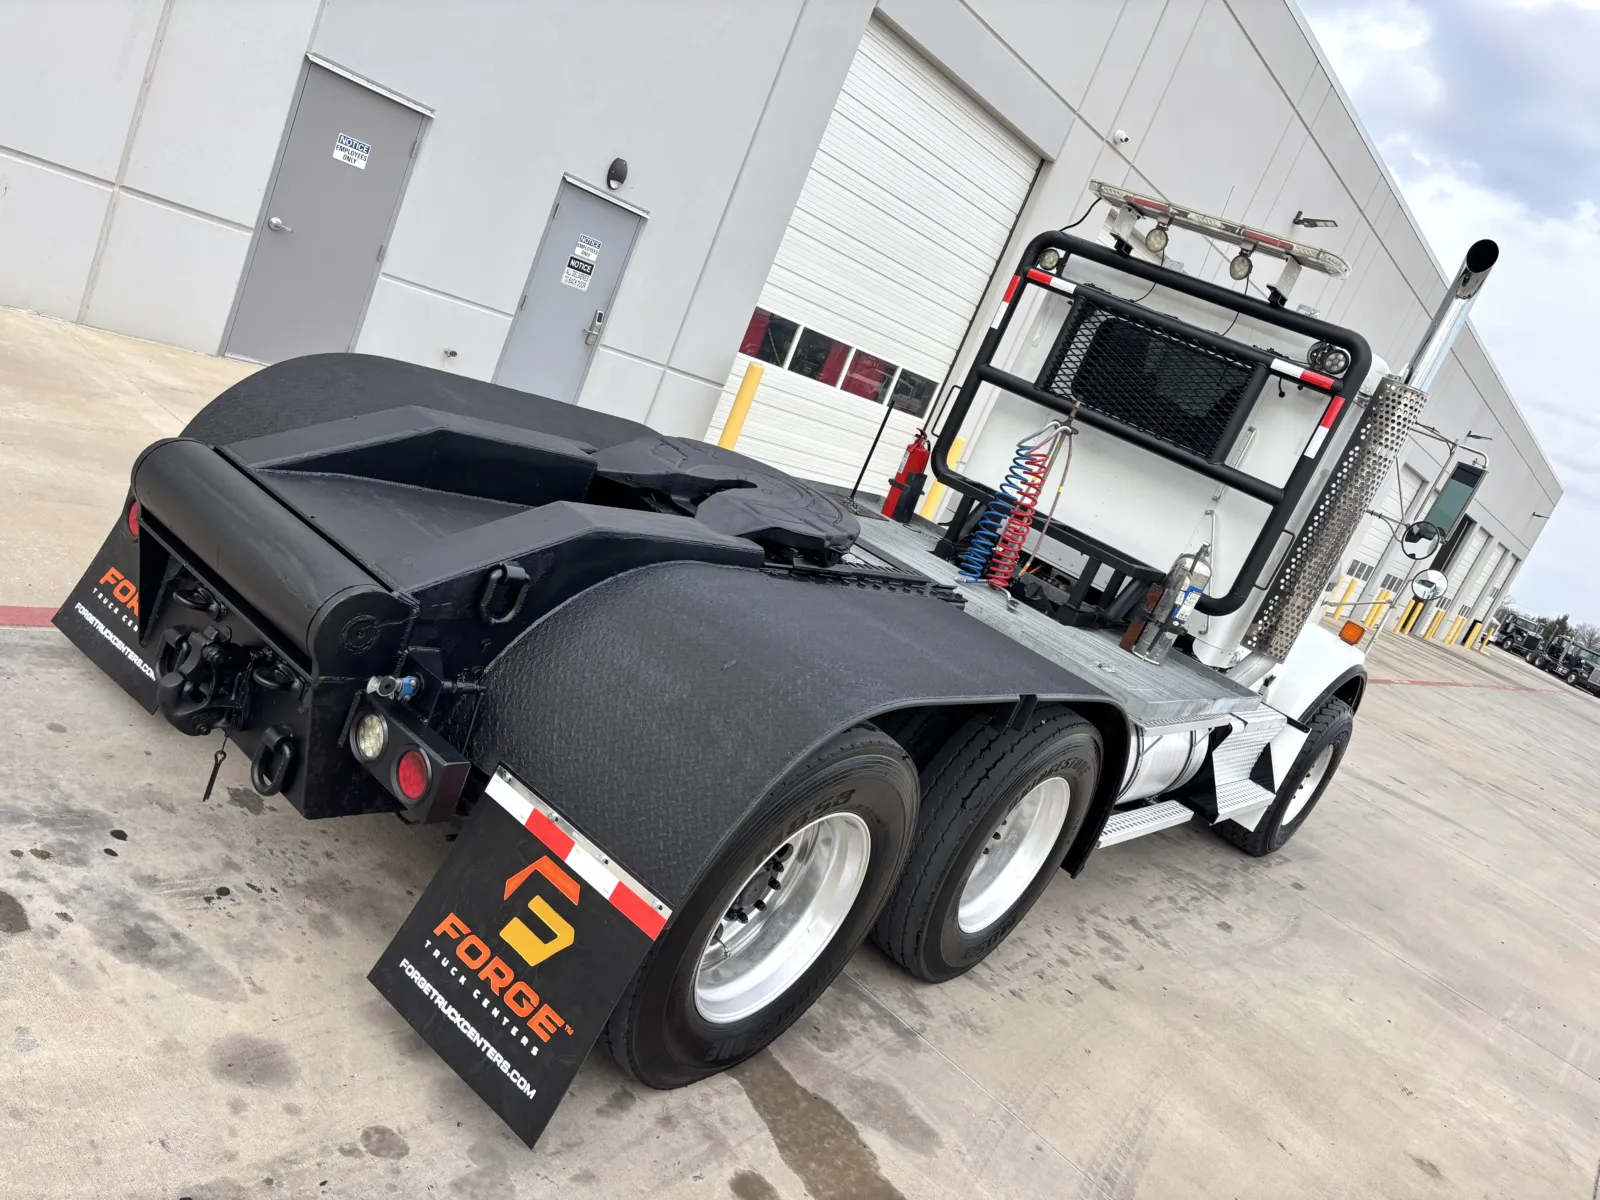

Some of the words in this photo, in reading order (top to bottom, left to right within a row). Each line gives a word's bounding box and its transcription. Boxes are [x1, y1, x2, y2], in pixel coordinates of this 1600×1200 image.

[336, 144, 367, 162] EMPLOYEES
[340, 136, 369, 154] NOTICE
[342, 154, 358, 164] ONLY
[581, 236, 602, 249] NOTICE
[570, 258, 592, 273] NOTICE
[92, 587, 120, 615] TRUCK
[424, 939, 468, 986] TRUCK
[472, 988, 540, 1056] CENTERS
[399, 958, 537, 1100] FORGETRUCKCENTERS.COM
